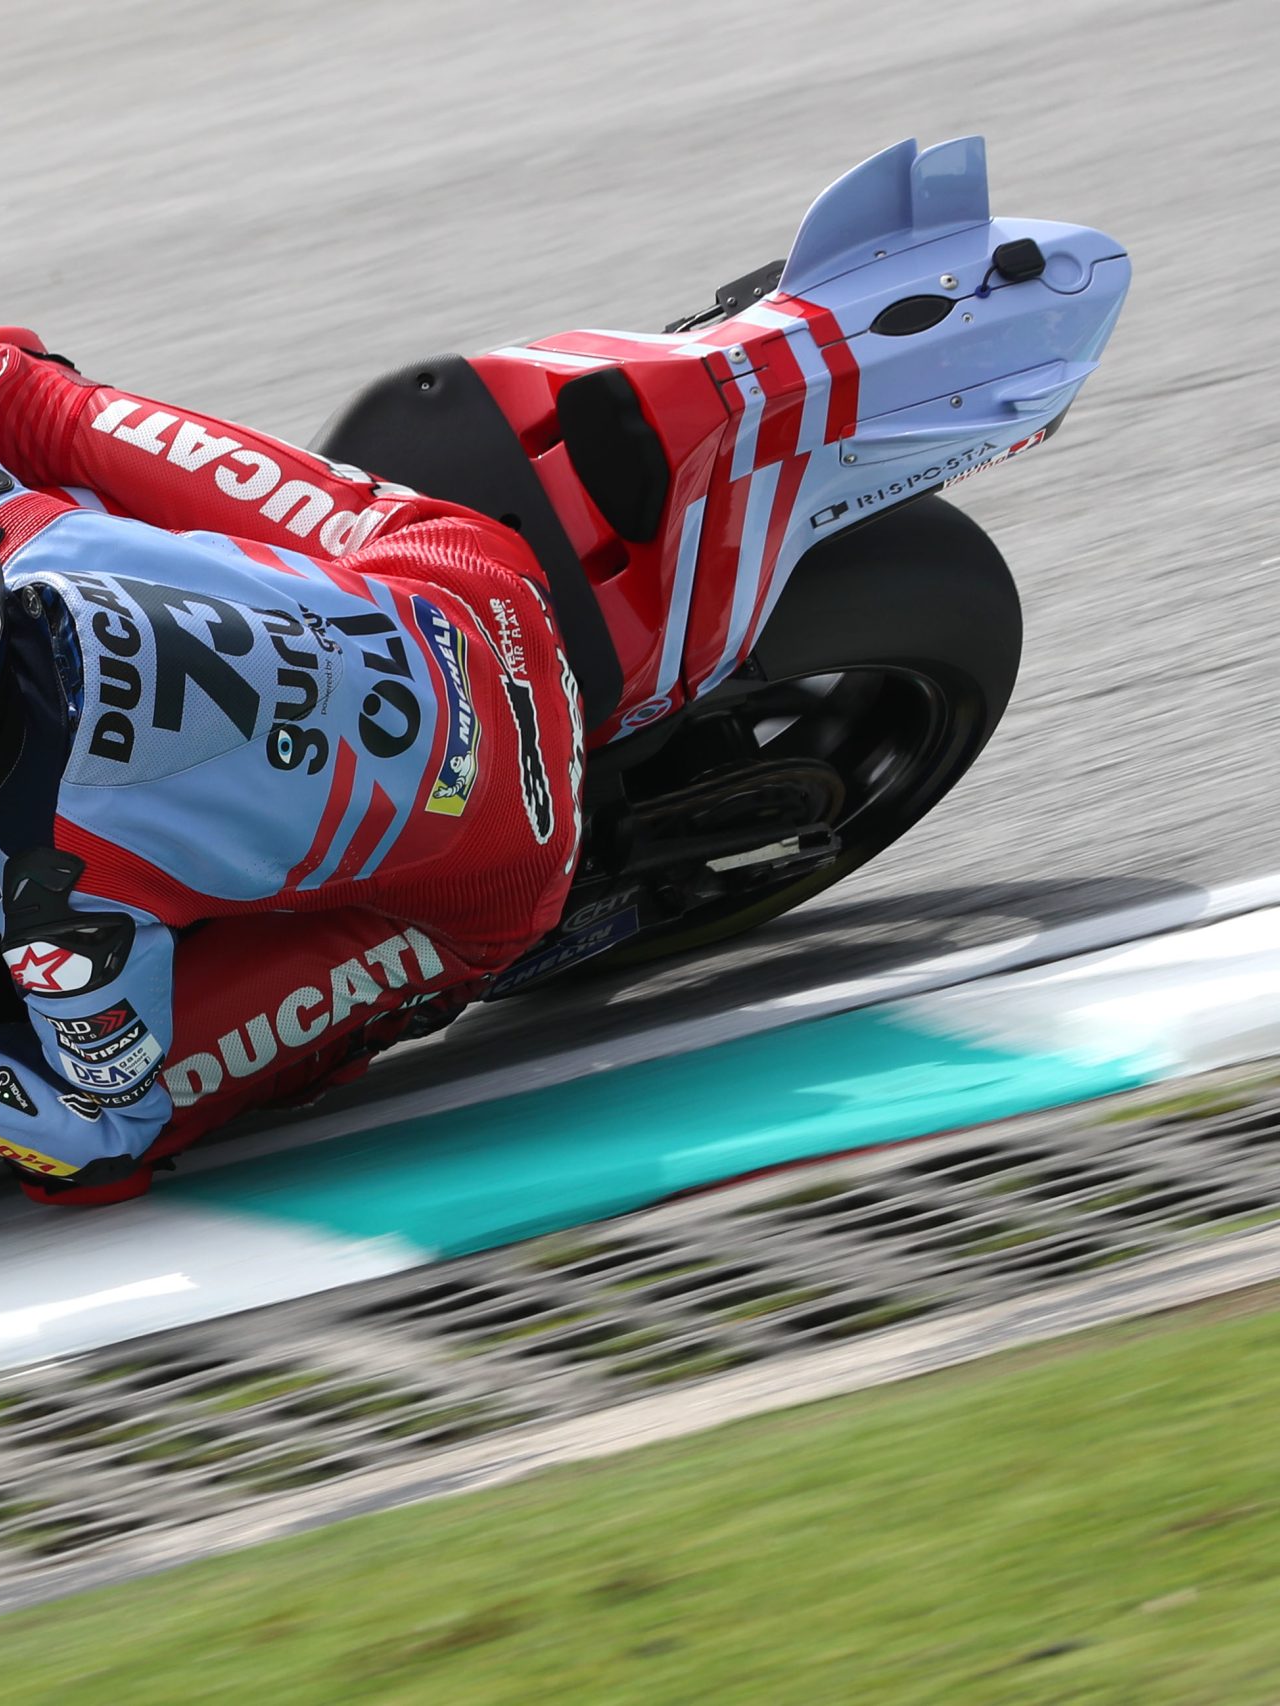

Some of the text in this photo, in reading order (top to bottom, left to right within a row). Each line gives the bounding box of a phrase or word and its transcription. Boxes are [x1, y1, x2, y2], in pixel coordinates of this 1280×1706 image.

[91, 399, 385, 557] DUCATI
[108, 576, 261, 741] 73
[320, 671, 334, 715] powered
[46, 1018, 92, 1035] OLD
[119, 1047, 145, 1069] gate
[163, 927, 445, 1107] DUCATI
